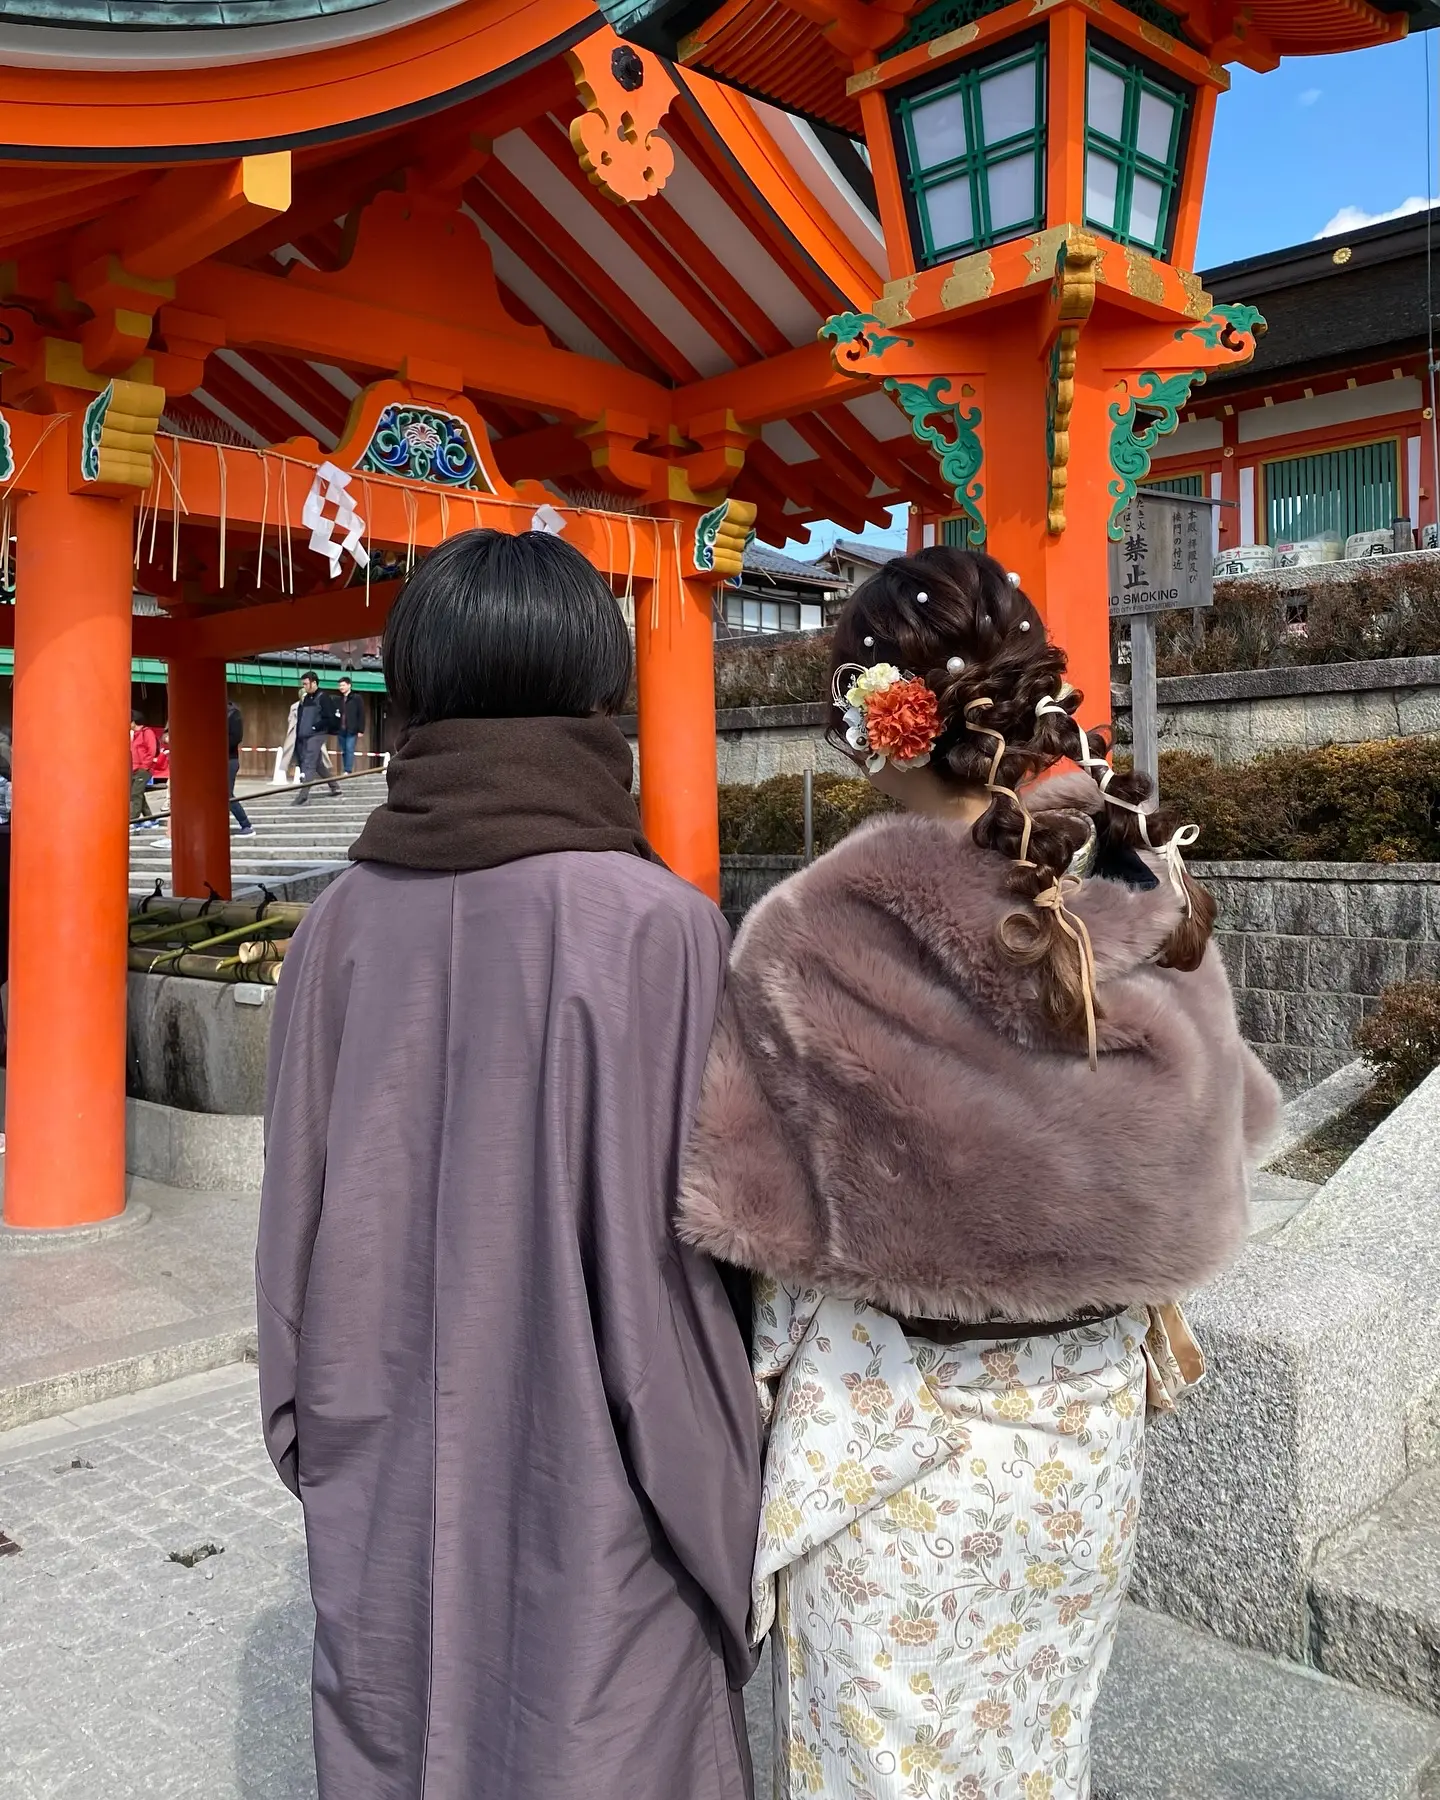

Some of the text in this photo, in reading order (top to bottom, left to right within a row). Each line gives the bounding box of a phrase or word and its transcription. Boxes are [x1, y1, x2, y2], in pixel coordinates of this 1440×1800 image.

[1136, 499, 1147, 531] たき火
[1123, 533, 1150, 590] 禁止
[1123, 588, 1179, 605] SMOKING
